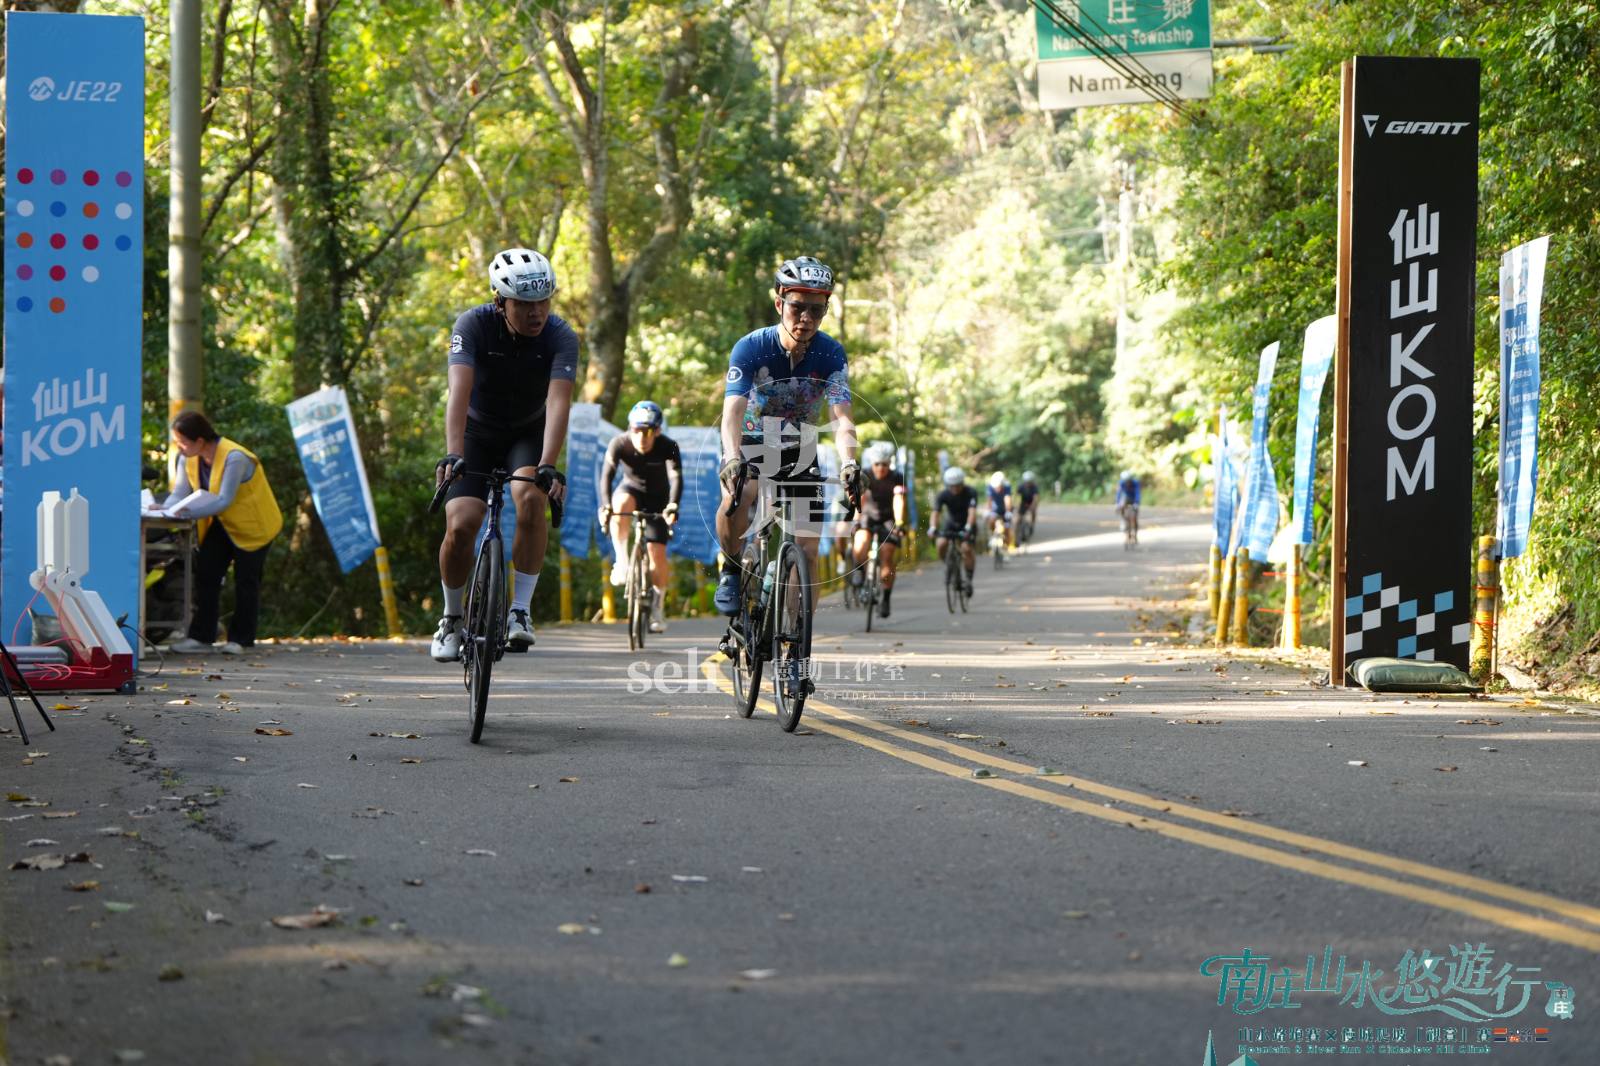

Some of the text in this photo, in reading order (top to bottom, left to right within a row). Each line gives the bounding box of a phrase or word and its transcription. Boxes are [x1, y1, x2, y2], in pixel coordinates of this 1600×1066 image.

[1132, 26, 1194, 45] Township
[57, 81, 122, 102] JE22
[1069, 72, 1182, 94] Namzong
[1384, 121, 1471, 135] GIANT
[32, 368, 108, 422] 仙山
[22, 405, 125, 467] KOM
